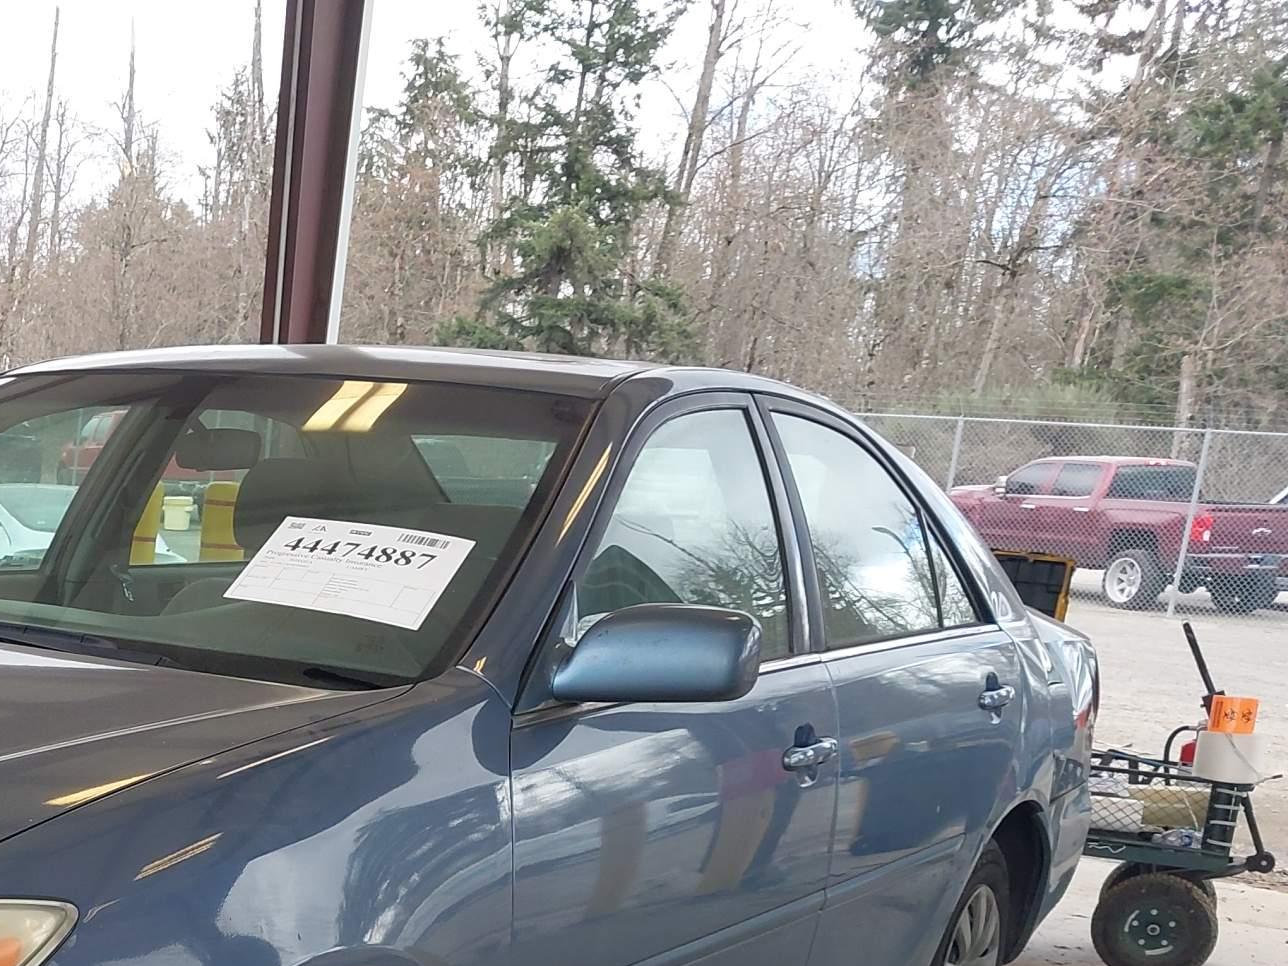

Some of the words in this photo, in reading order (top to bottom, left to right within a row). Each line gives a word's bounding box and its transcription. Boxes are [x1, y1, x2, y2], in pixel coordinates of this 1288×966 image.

[284, 536, 439, 570] 44474887
[310, 554, 343, 564] Casualty
[345, 558, 383, 569] Insurance
